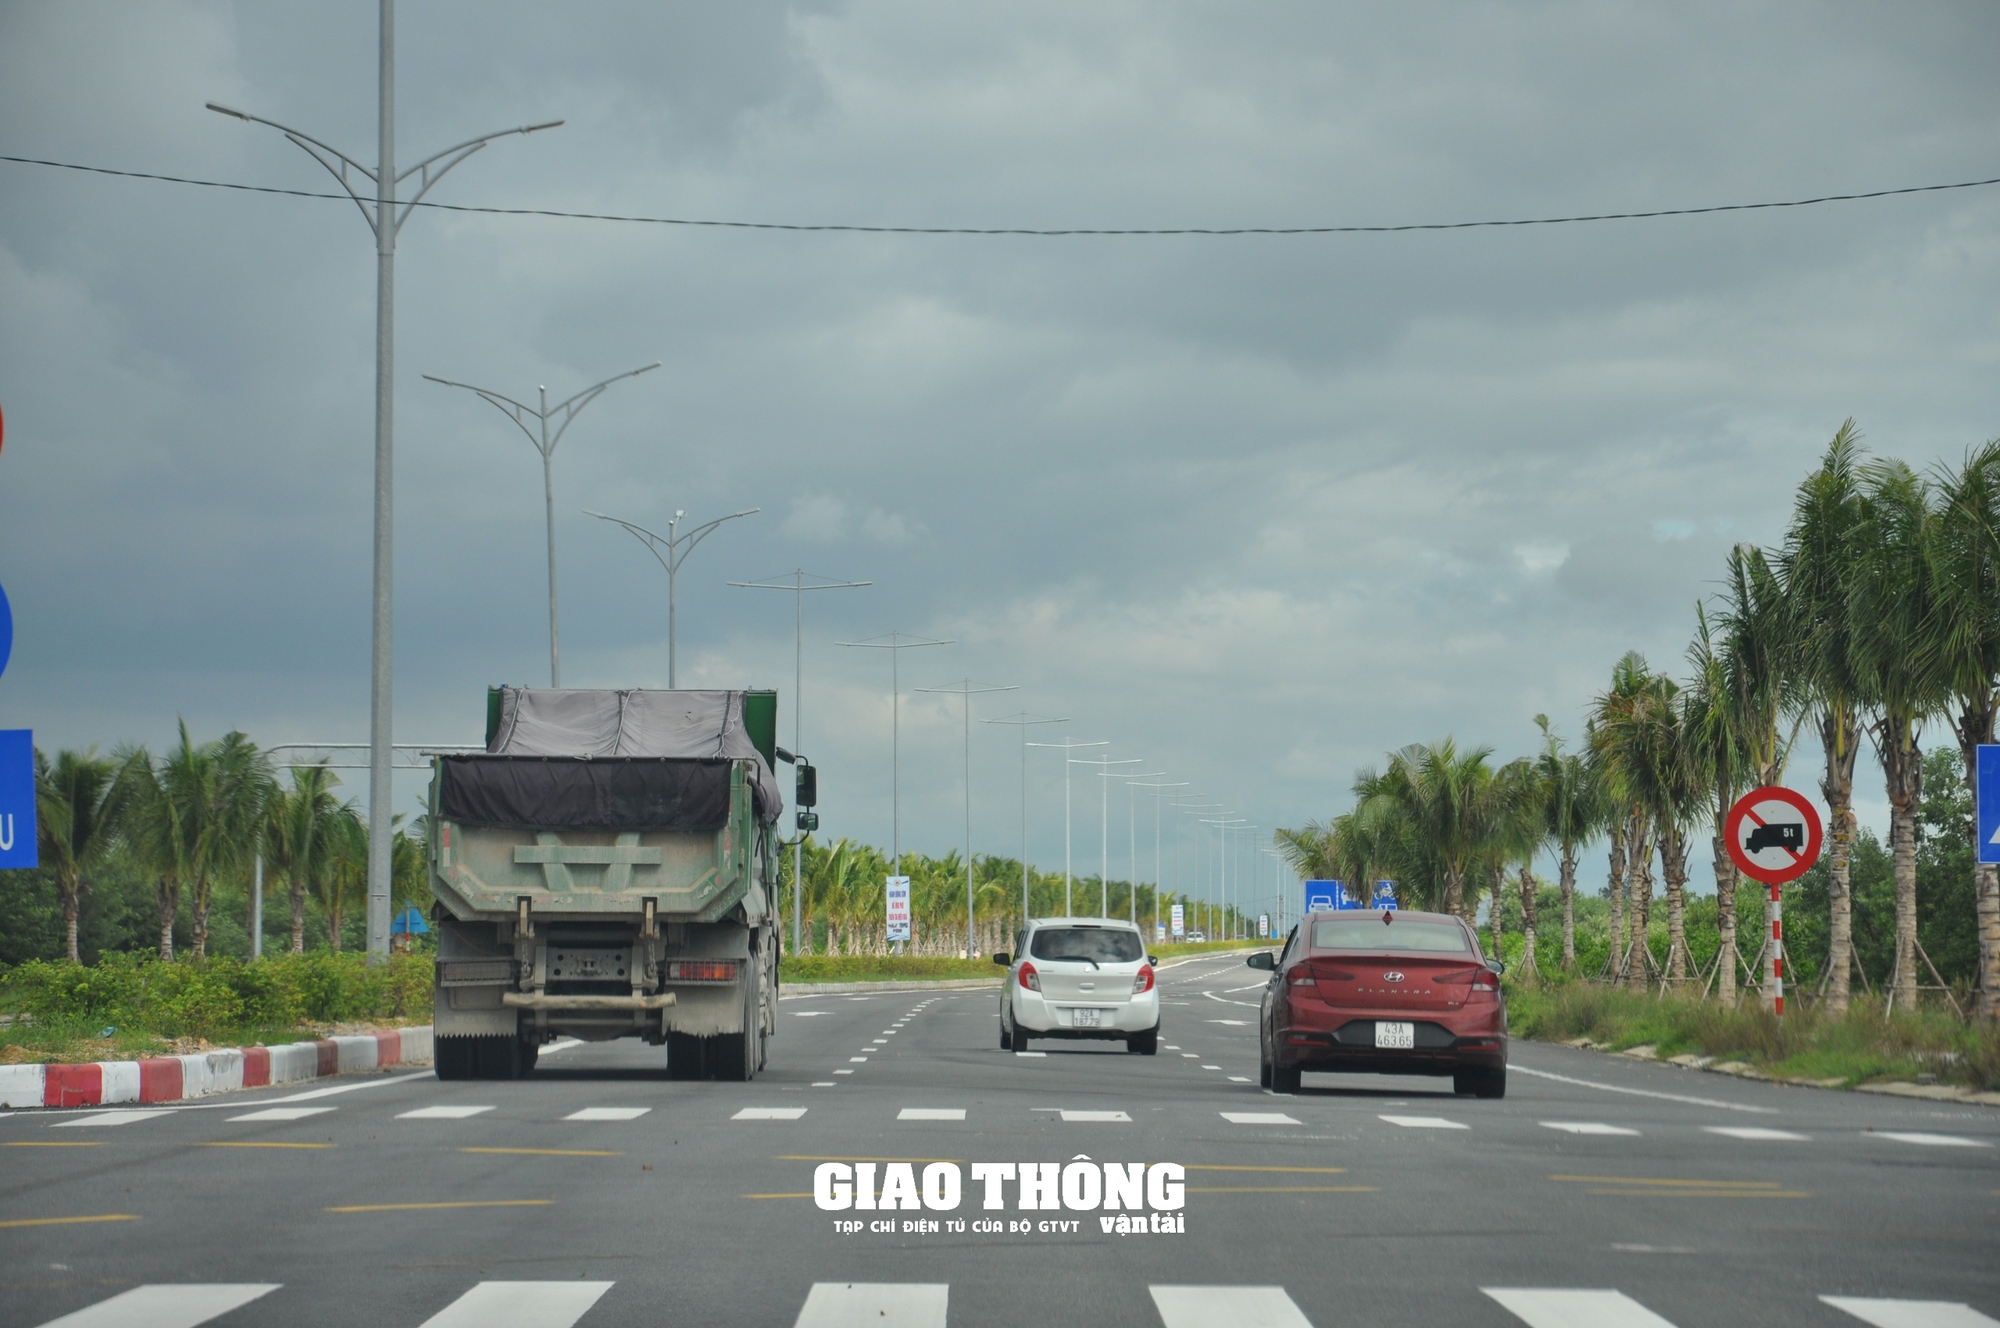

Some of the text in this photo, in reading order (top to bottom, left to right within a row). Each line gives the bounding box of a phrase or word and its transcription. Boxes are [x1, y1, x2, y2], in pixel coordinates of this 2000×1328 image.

[1783, 827, 1794, 838] 5t
[1357, 987, 1431, 995] ELANTRA
[1384, 1023, 1405, 1035] 43A
[1377, 1035, 1412, 1047] 463.65
